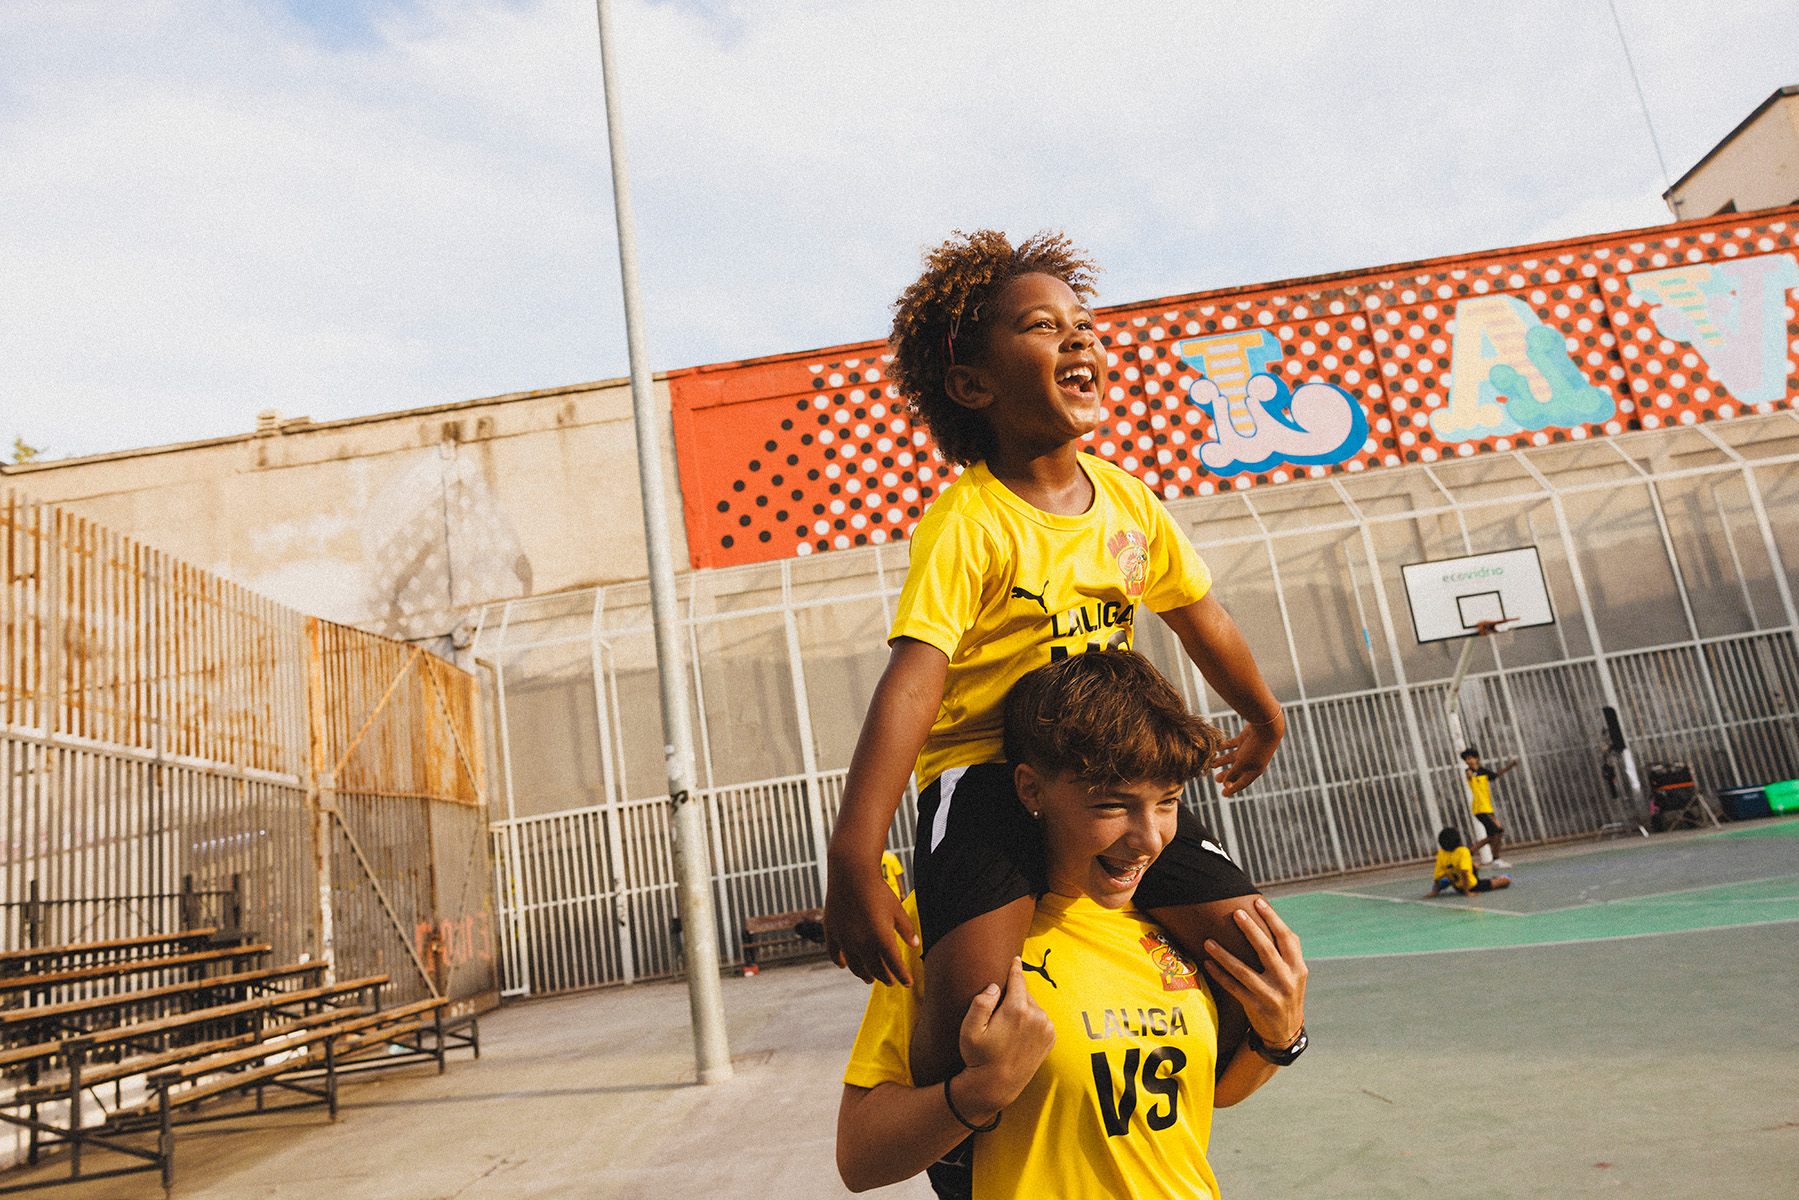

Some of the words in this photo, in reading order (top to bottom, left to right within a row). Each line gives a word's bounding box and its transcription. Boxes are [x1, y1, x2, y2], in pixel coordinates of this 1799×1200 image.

[1051, 601, 1134, 638] LALIGA
[1082, 1006, 1188, 1040] LALIGA
[1091, 1046, 1187, 1137] VS
